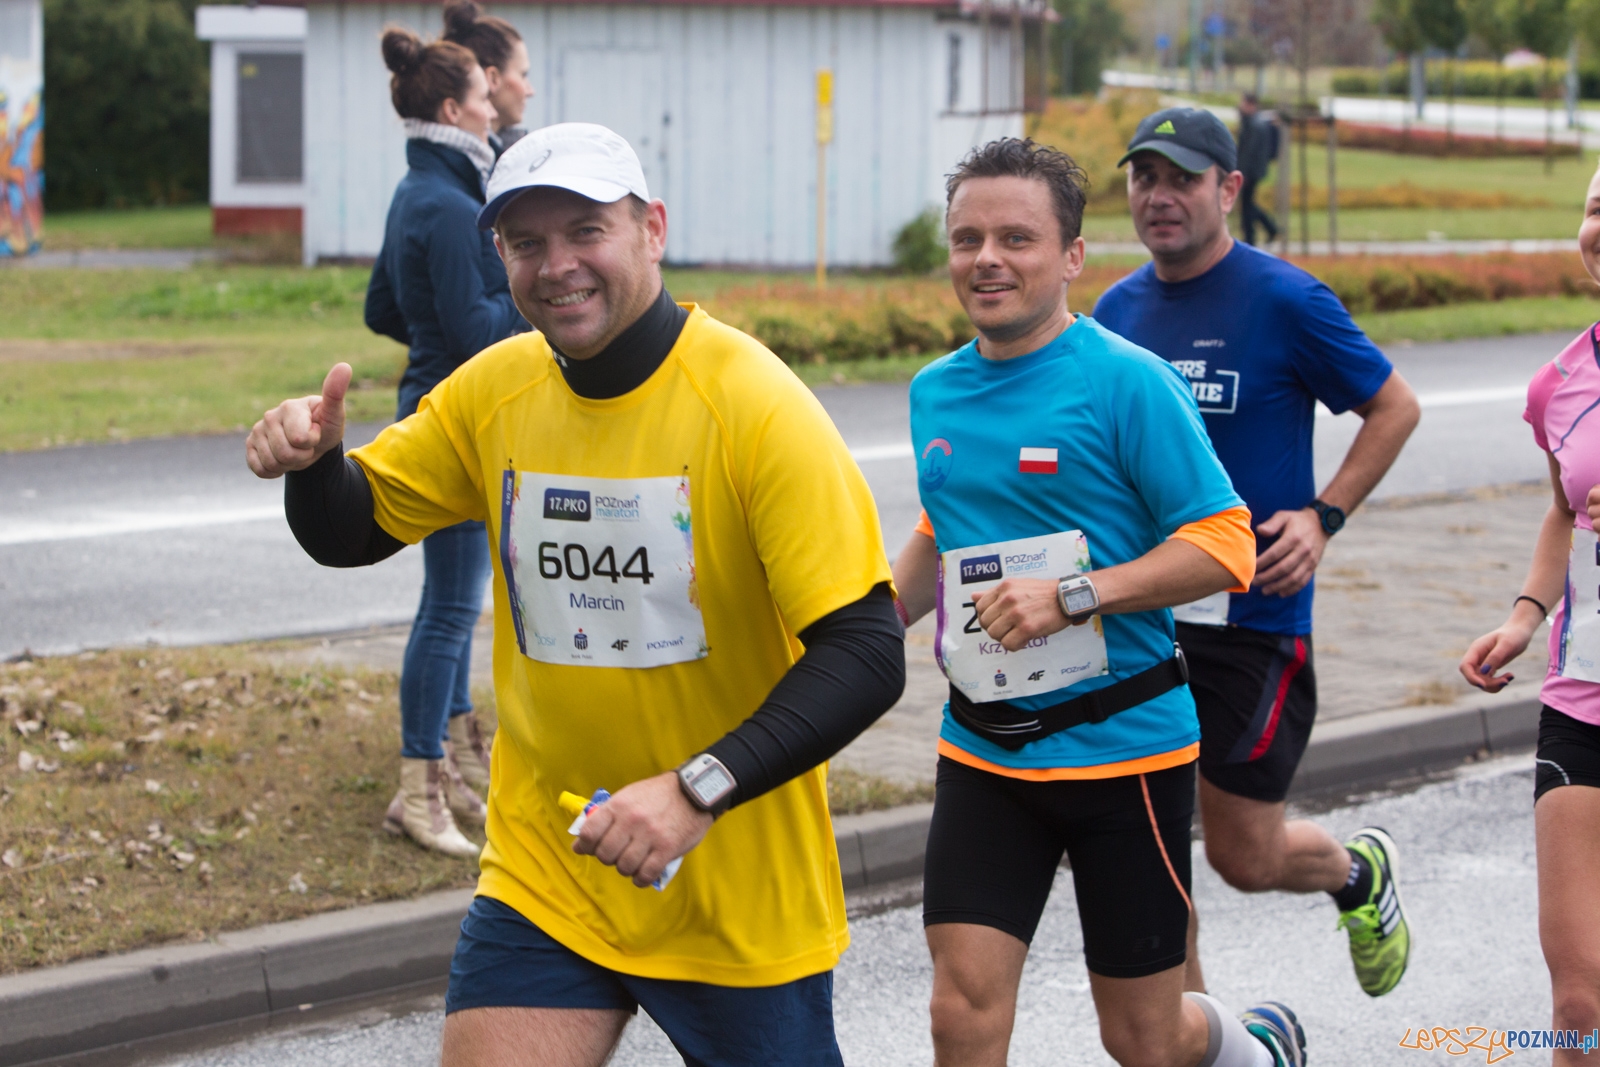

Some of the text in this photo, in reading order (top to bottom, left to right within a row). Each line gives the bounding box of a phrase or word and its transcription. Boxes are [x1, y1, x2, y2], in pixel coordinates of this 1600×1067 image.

[1171, 360, 1207, 378] ERS
[549, 496, 588, 514] 17.PKO
[596, 507, 640, 518] maraton
[538, 541, 655, 585] 6044
[962, 561, 999, 577] 17.PKO
[1006, 560, 1048, 573] maraton
[569, 592, 625, 611] Marcin
